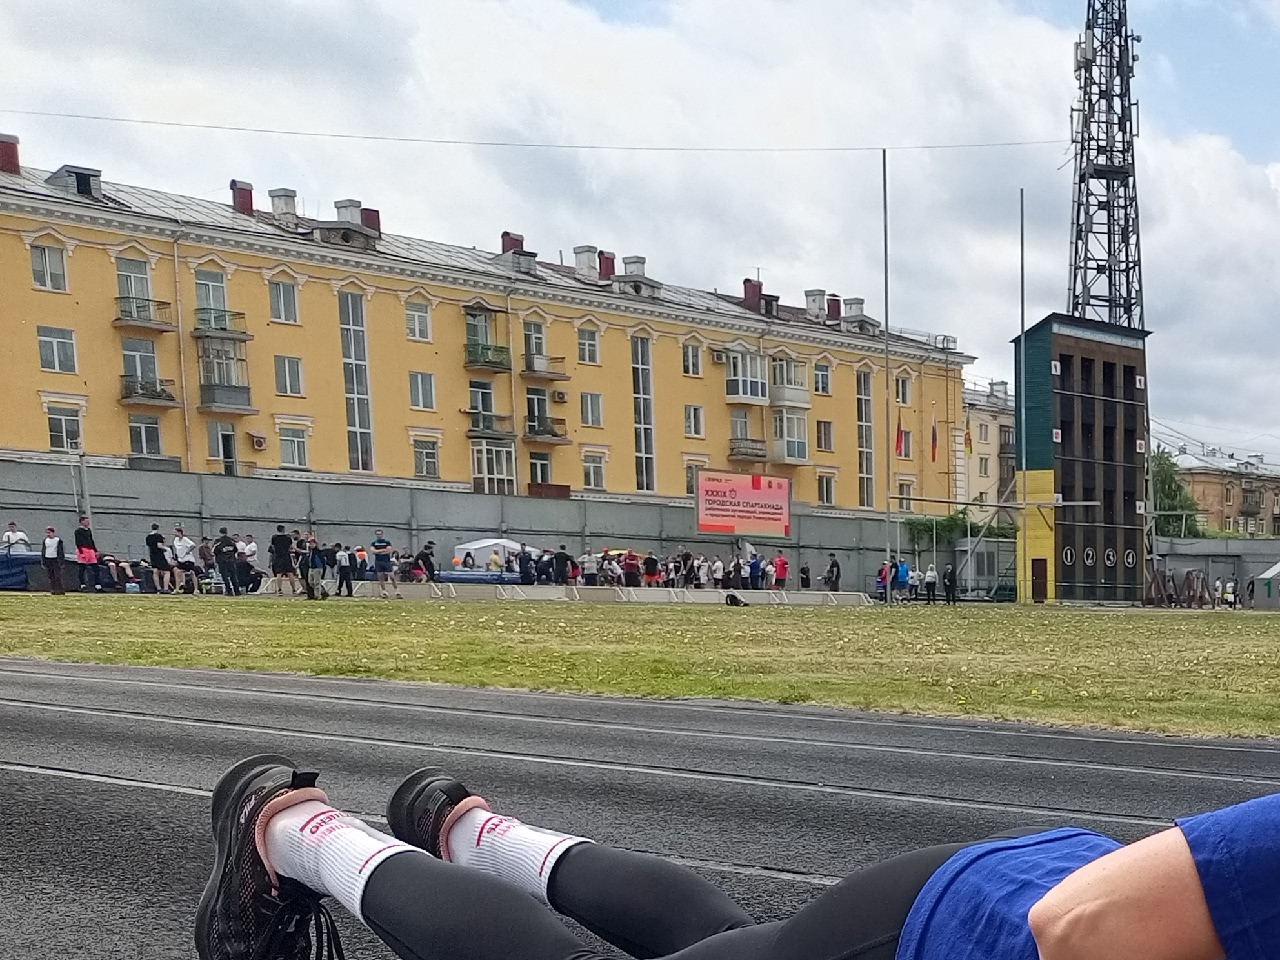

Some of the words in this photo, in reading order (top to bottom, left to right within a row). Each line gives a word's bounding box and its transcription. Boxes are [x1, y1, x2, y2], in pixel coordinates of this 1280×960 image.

[705, 499, 741, 507] ГОРОДСКАЯ
[742, 501, 783, 510] СПАРТАКИАДА
[1263, 580, 1271, 598] 1
